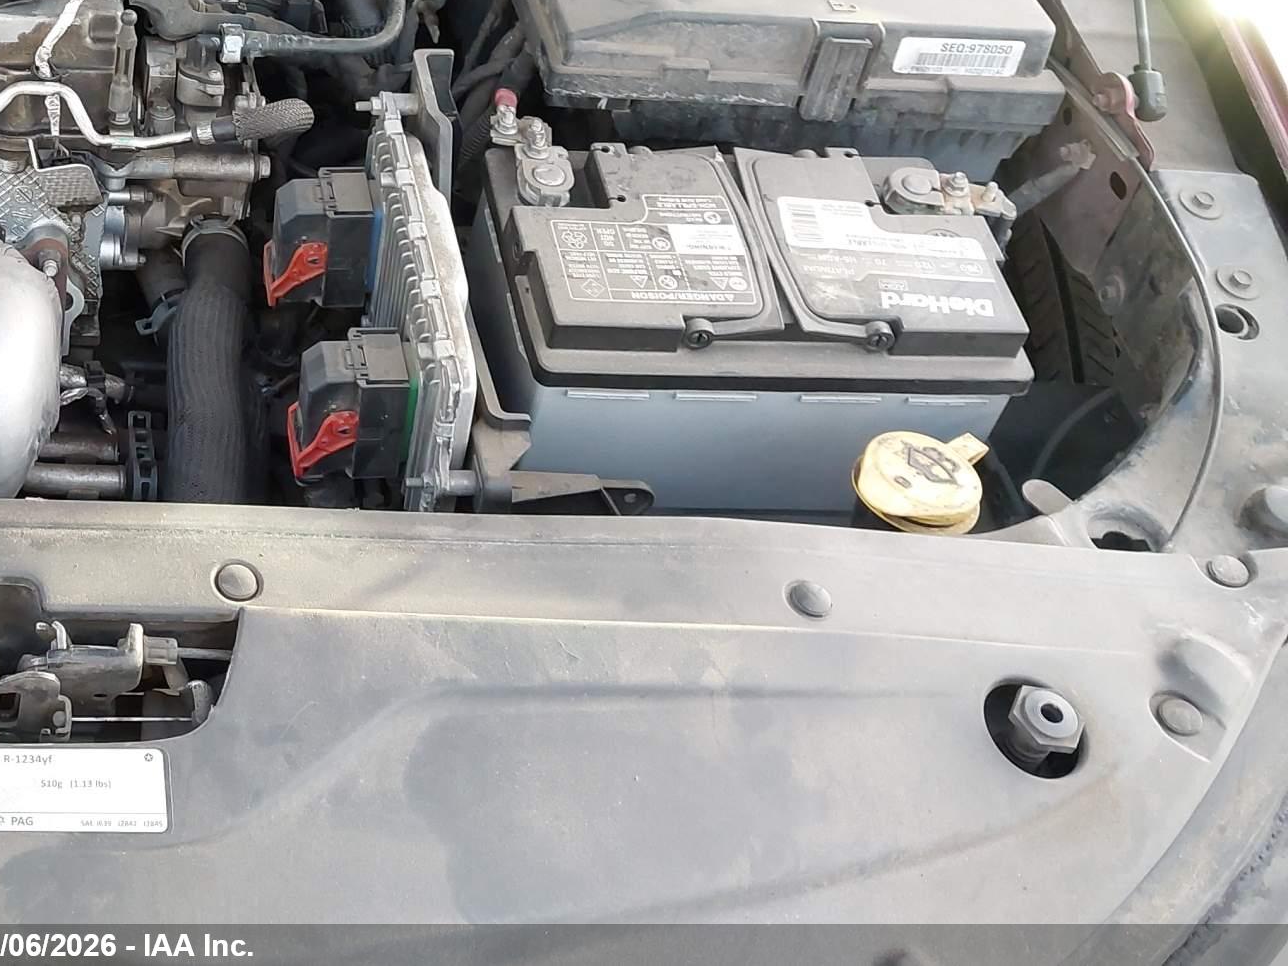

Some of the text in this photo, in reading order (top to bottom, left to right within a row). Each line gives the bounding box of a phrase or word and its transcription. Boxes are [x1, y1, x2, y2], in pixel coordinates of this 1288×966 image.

[940, 42, 1013, 54] SEQ:978050
[631, 291, 725, 301] DANGER/POISON
[880, 291, 994, 317] DieHard
[3, 754, 53, 766] R-1234yf
[41, 779, 112, 789] 510g (1.13 lbs)
[11, 817, 34, 826] PAG
